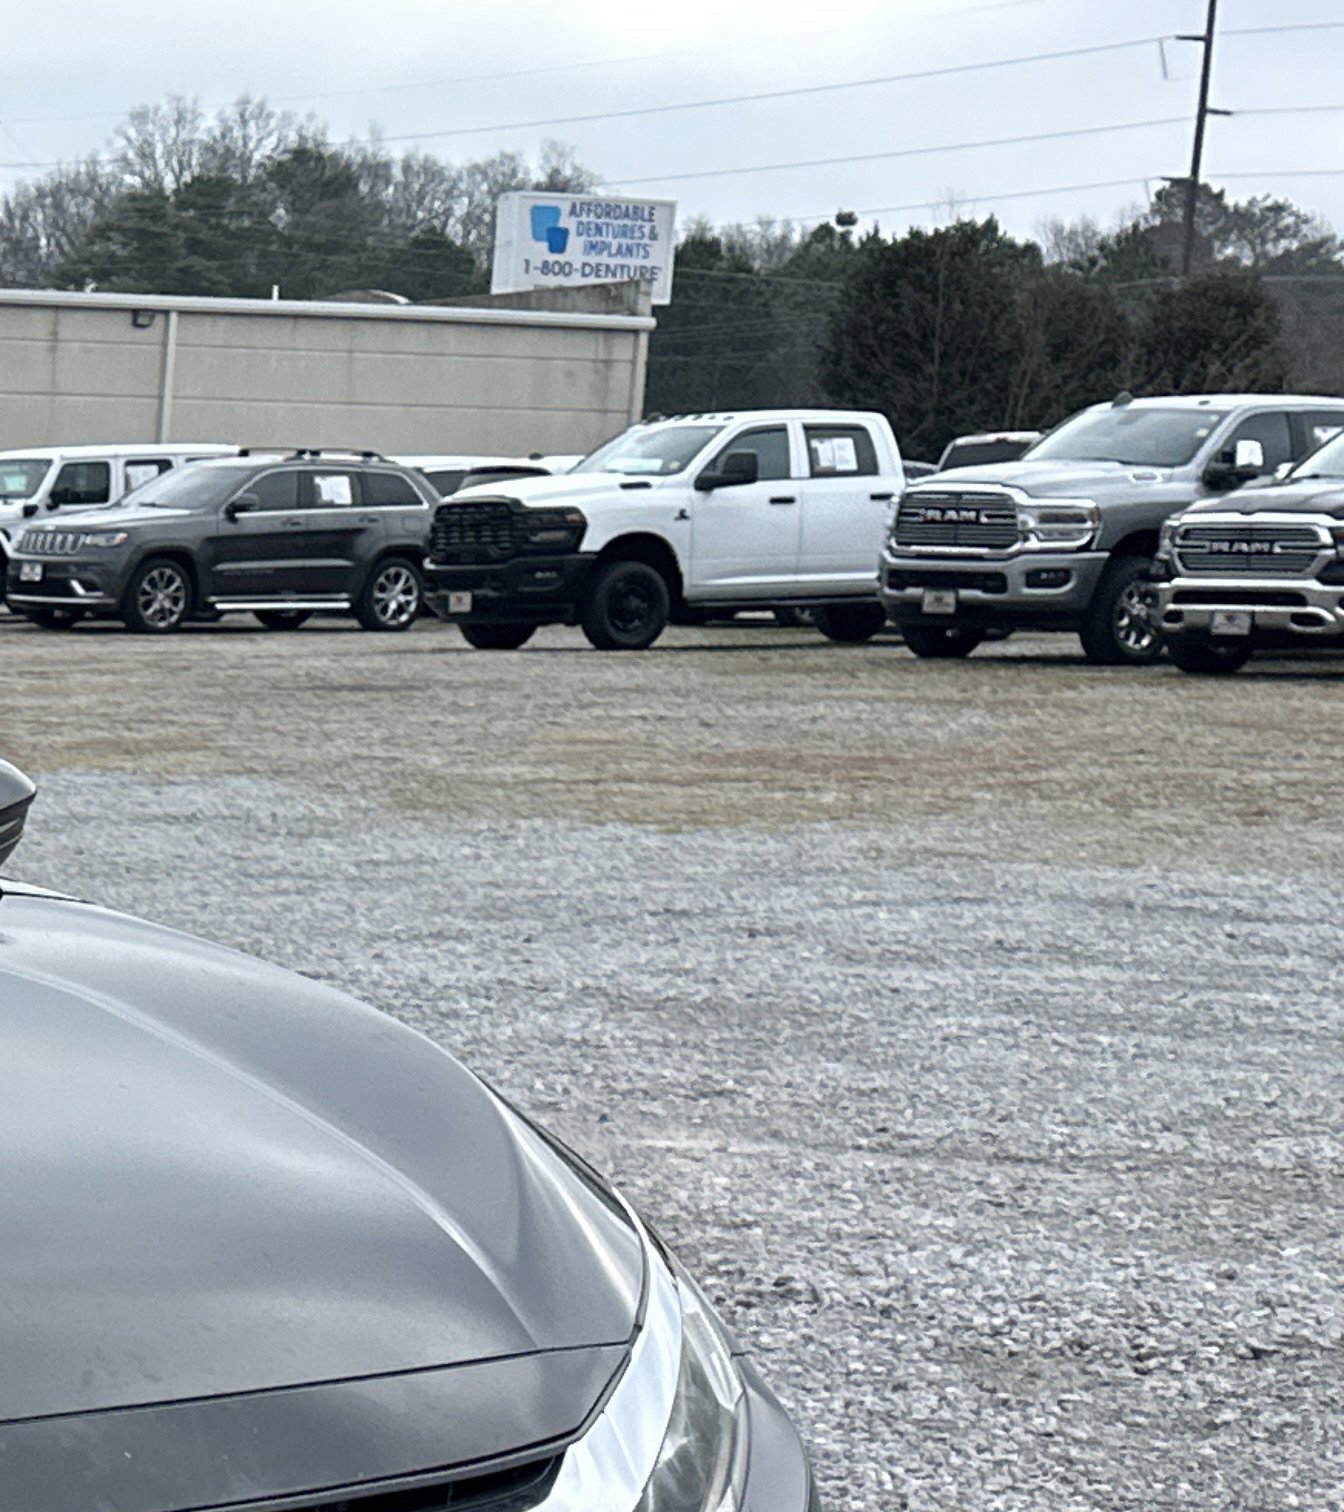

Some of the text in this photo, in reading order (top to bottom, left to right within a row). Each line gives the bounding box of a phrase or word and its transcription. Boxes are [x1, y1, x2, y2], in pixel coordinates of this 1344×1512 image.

[569, 201, 656, 223] AFFORDABLE
[575, 220, 658, 242] DENTURES &
[583, 240, 650, 260] IMPLANTS
[523, 258, 660, 282] 1-800-DENTURE
